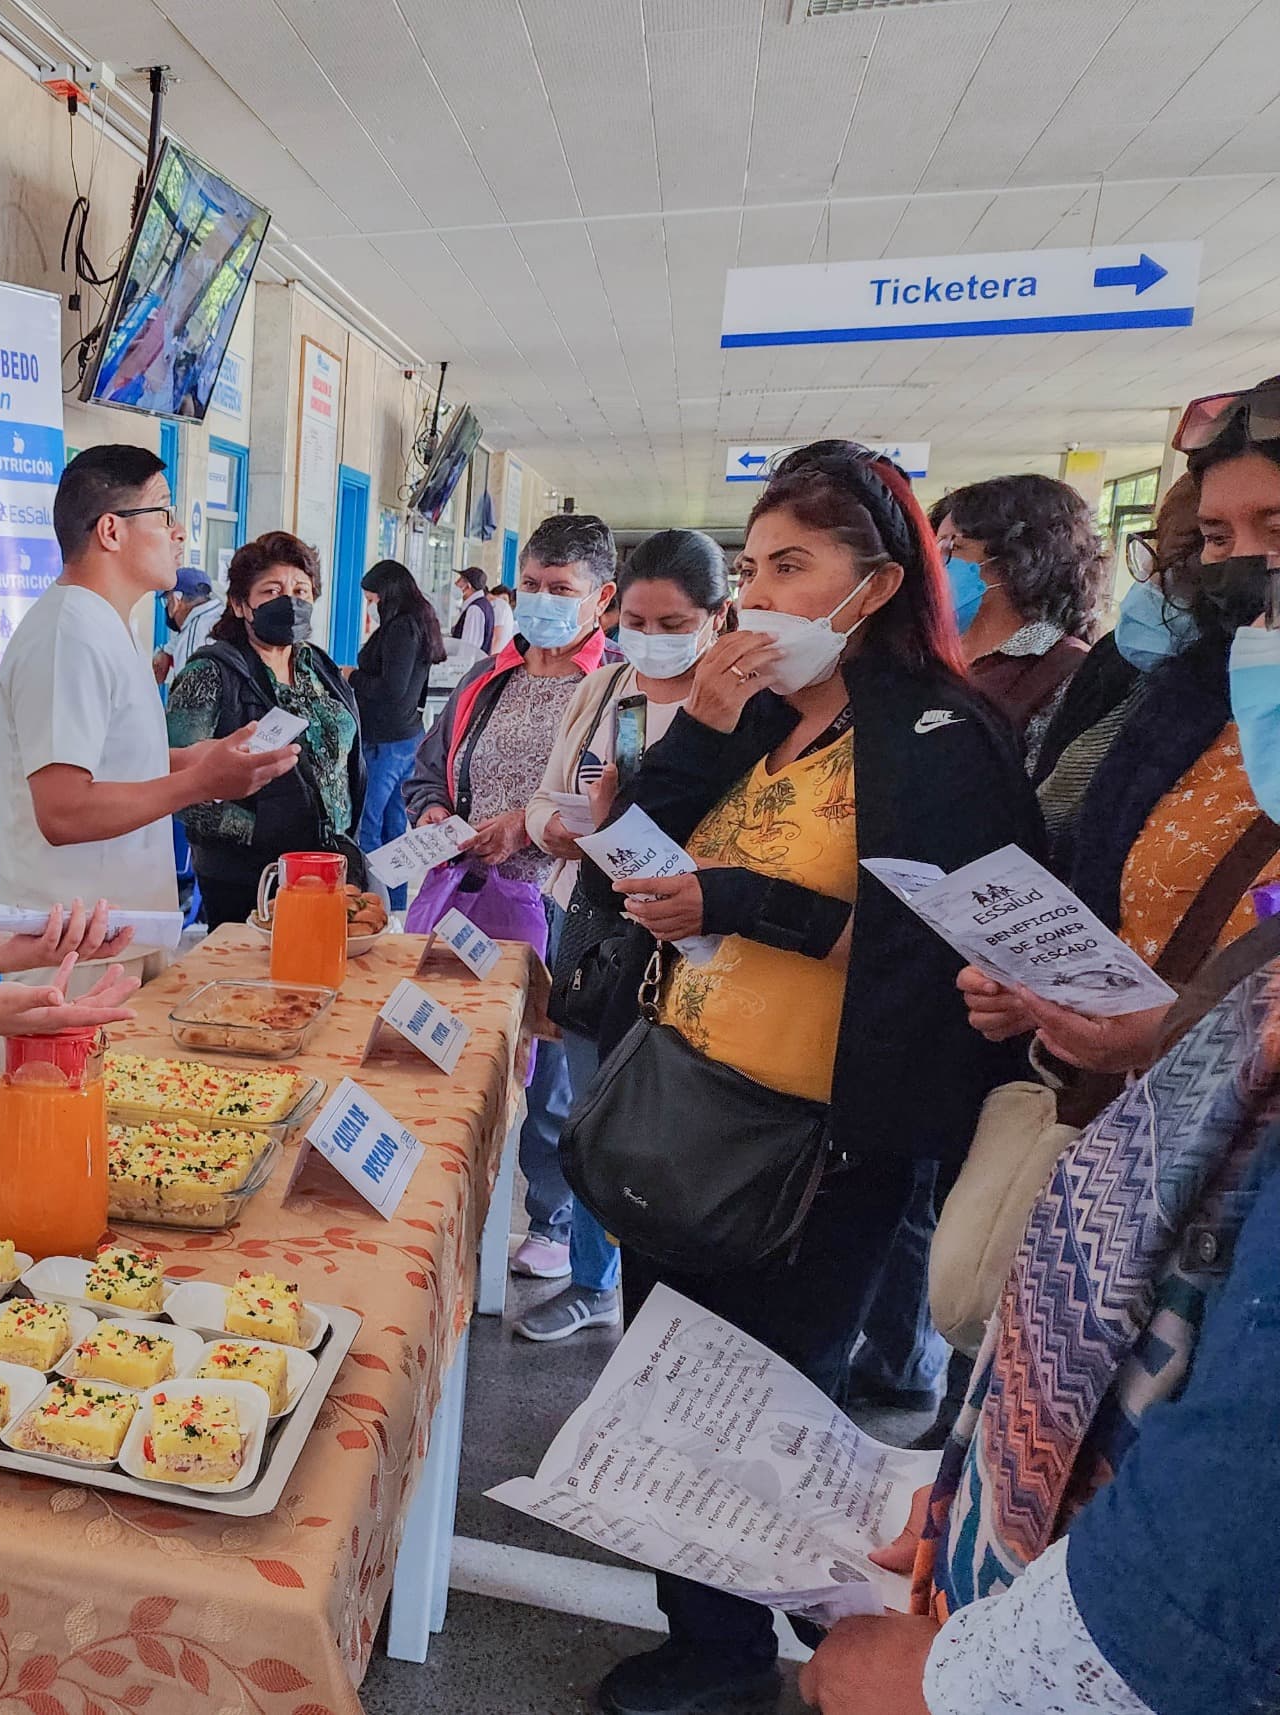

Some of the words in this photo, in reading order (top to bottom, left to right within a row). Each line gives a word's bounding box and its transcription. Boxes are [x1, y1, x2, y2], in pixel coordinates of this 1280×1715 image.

[869, 274, 1038, 306] Ticketera
[972, 887, 1044, 926] EsSalud
[984, 904, 1079, 947] BENEFICIOS
[1009, 940, 1034, 955] DE
[1035, 922, 1088, 945] COMER
[1029, 938, 1099, 966] PESCADO
[331, 1115, 363, 1153] CAUSA
[347, 1103, 370, 1128] DE
[361, 1132, 399, 1185] PESCADO
[632, 1364, 654, 1388] Tipos
[649, 1351, 662, 1363] de
[658, 1317, 682, 1352] pescado
[665, 1354, 687, 1384] Azules
[665, 1387, 687, 1416] Habitan
[785, 1425, 810, 1456] Blancos
[567, 1476, 579, 1488] El
[578, 1442, 599, 1471] consumo
[588, 1454, 615, 1495] contribuye
